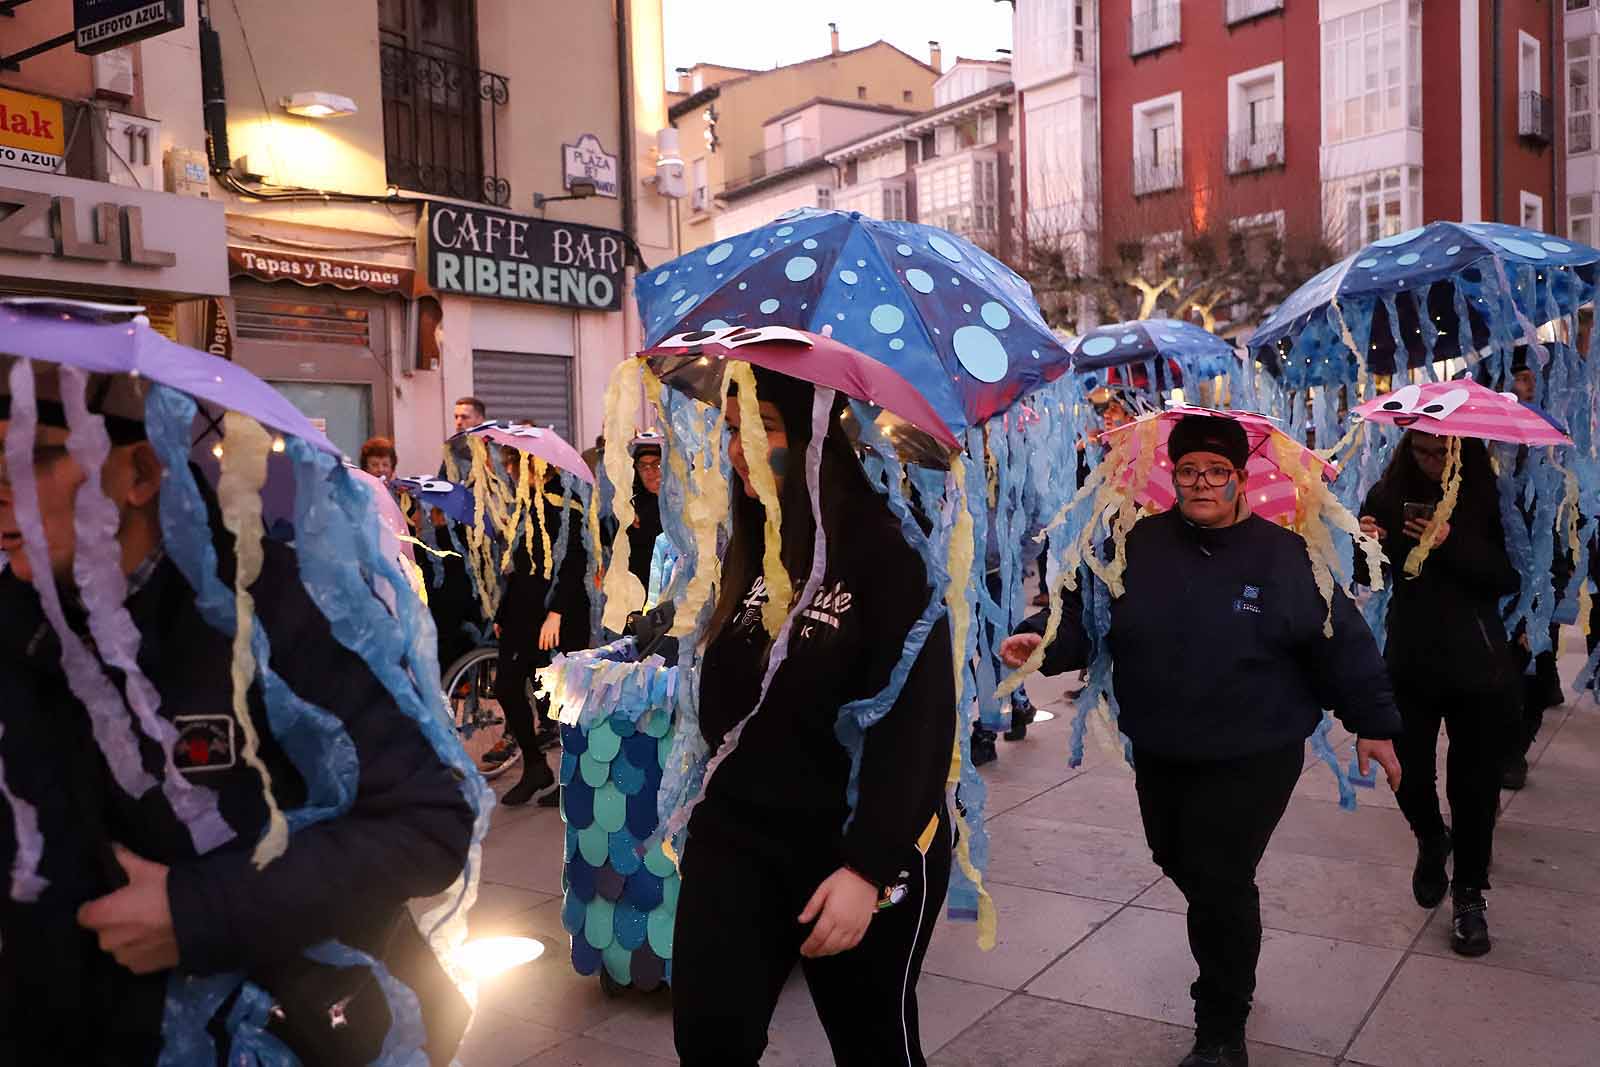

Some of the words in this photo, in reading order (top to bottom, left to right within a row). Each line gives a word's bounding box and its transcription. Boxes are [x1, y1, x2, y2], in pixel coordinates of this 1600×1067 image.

[80, 15, 133, 43] TELEFOTO
[135, 4, 164, 25] AZUL
[21, 152, 57, 168] AZUL
[123, 125, 150, 166] 11
[574, 151, 610, 170] PLAZA
[432, 208, 530, 259] CAFE
[552, 228, 618, 274] BAR
[241, 252, 301, 275] Tapas
[304, 263, 316, 278] y
[319, 261, 400, 285] Raciones
